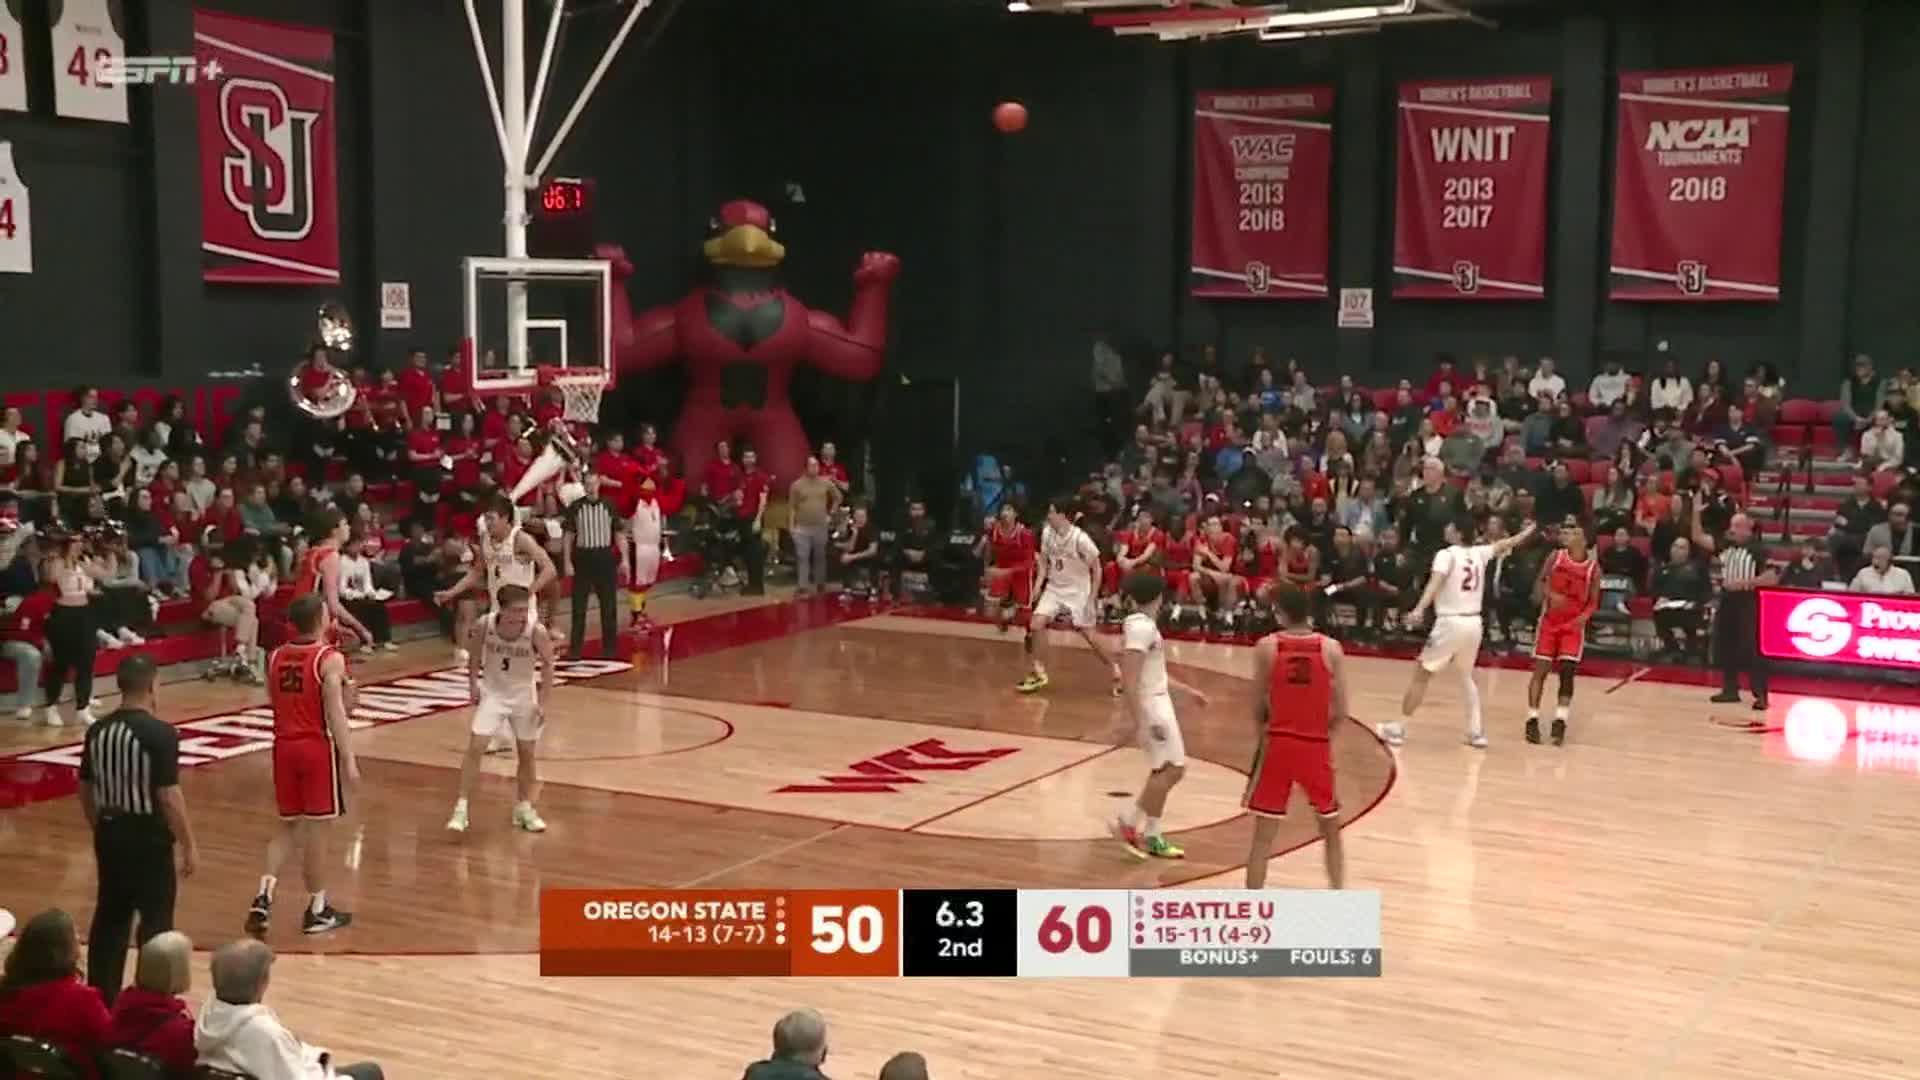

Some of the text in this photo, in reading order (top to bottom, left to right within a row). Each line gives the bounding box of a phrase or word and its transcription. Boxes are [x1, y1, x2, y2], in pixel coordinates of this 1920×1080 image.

[1431, 126, 1515, 162] WNIT
[1645, 117, 1751, 150] NCAA
[1231, 134, 1296, 161] WAC
[1239, 183, 1285, 205] 2013
[1444, 177, 1495, 201] 2013
[1669, 176, 1728, 202] 2018
[1239, 209, 1286, 231] 2018
[1443, 205, 1494, 228] 2017
[1461, 566, 1480, 591] 21
[501, 657, 511, 671] 5
